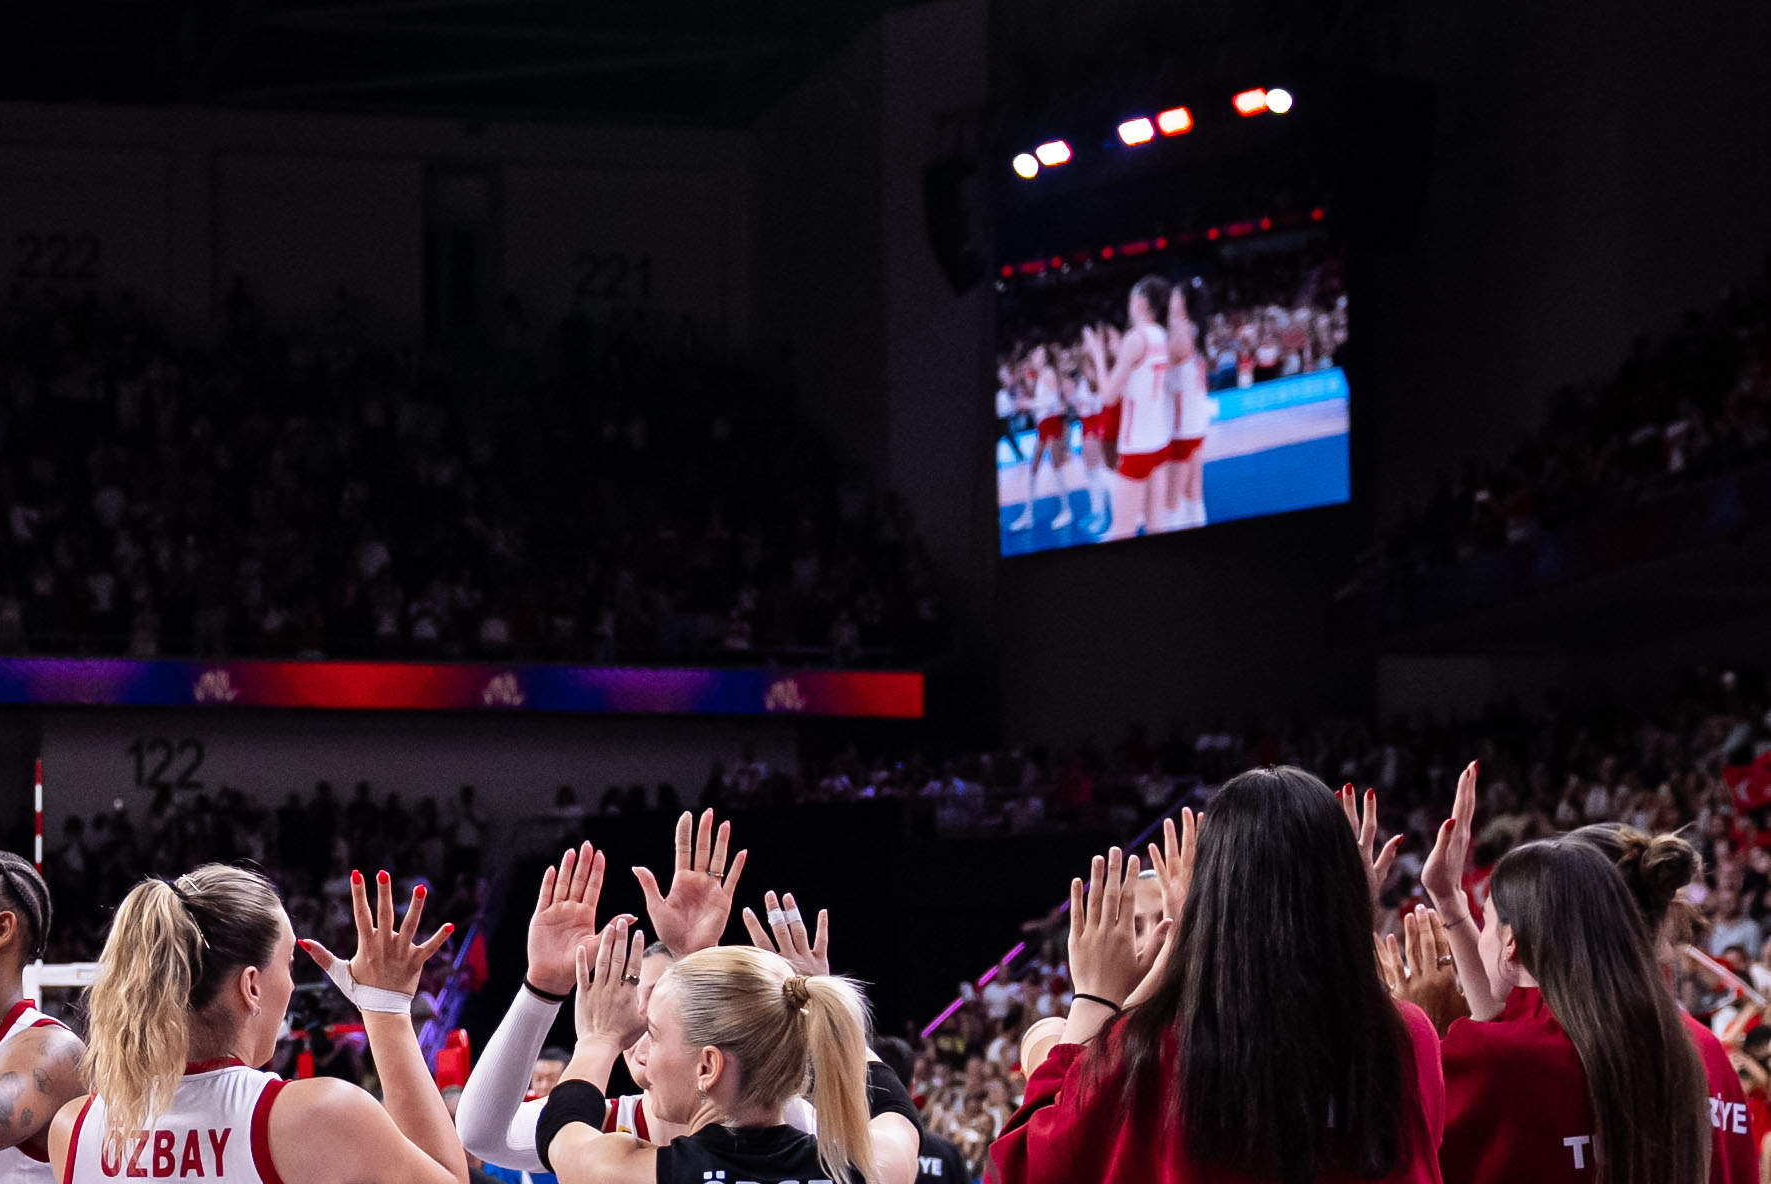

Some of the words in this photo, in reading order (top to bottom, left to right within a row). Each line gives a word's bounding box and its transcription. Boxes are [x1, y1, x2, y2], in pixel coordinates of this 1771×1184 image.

[16, 233, 102, 280] 222
[573, 252, 652, 299] 221
[126, 737, 205, 788] 122
[918, 1156, 943, 1176] YE
